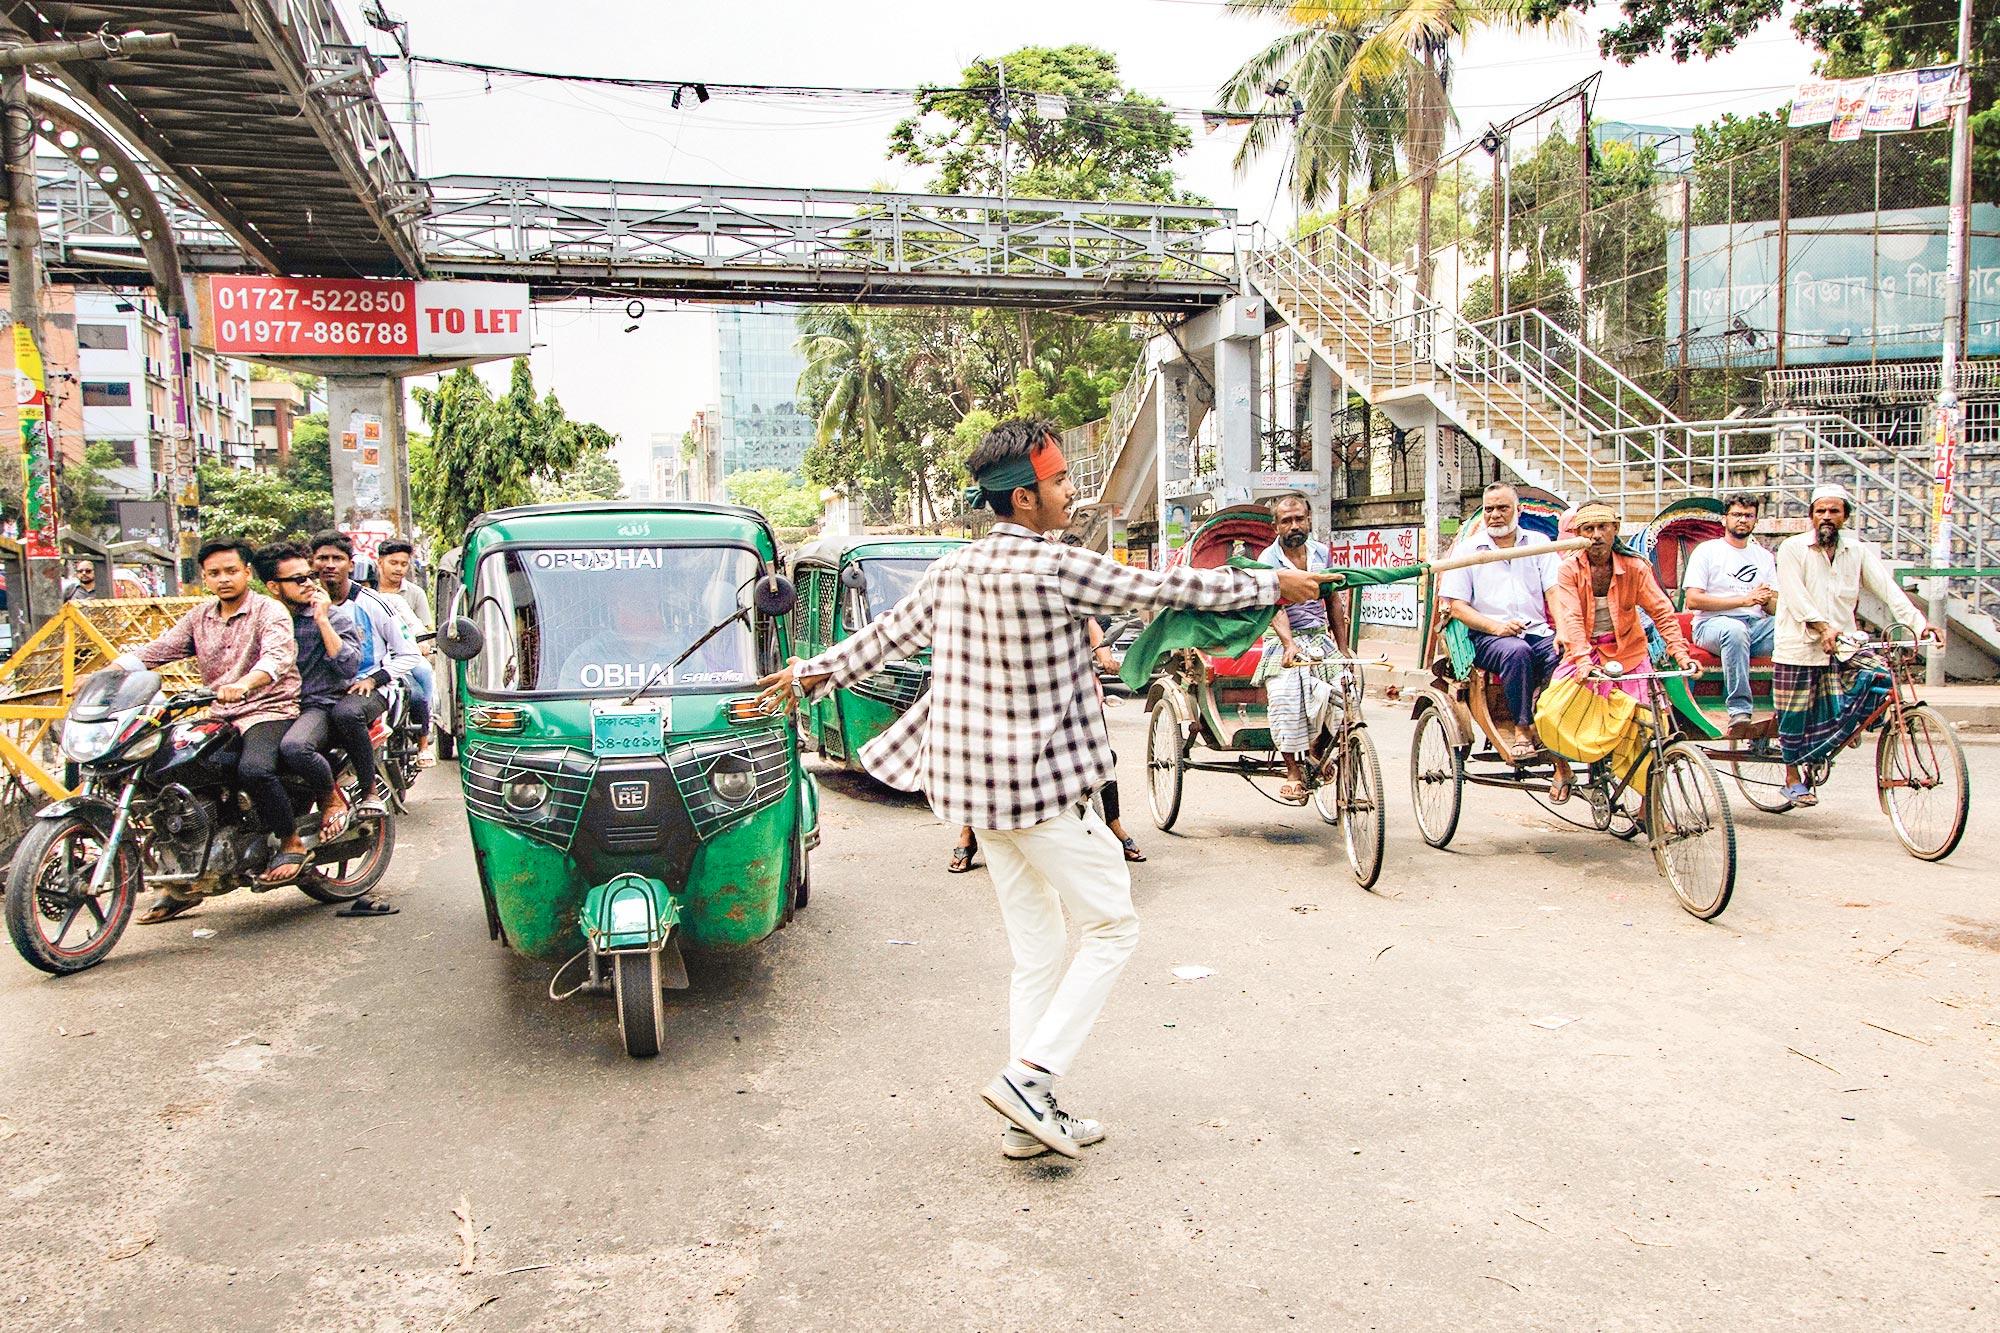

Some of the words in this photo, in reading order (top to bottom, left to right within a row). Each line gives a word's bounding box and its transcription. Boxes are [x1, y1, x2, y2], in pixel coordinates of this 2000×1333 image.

[219, 287, 406, 313] 01727-522850
[1793, 271, 1869, 307] বিজ্ঞান
[222, 318, 408, 345] 01977-886788
[425, 308, 465, 334] TO
[474, 308, 523, 334] LET
[580, 662, 675, 688] OBHAI
[618, 790, 643, 806] RE
